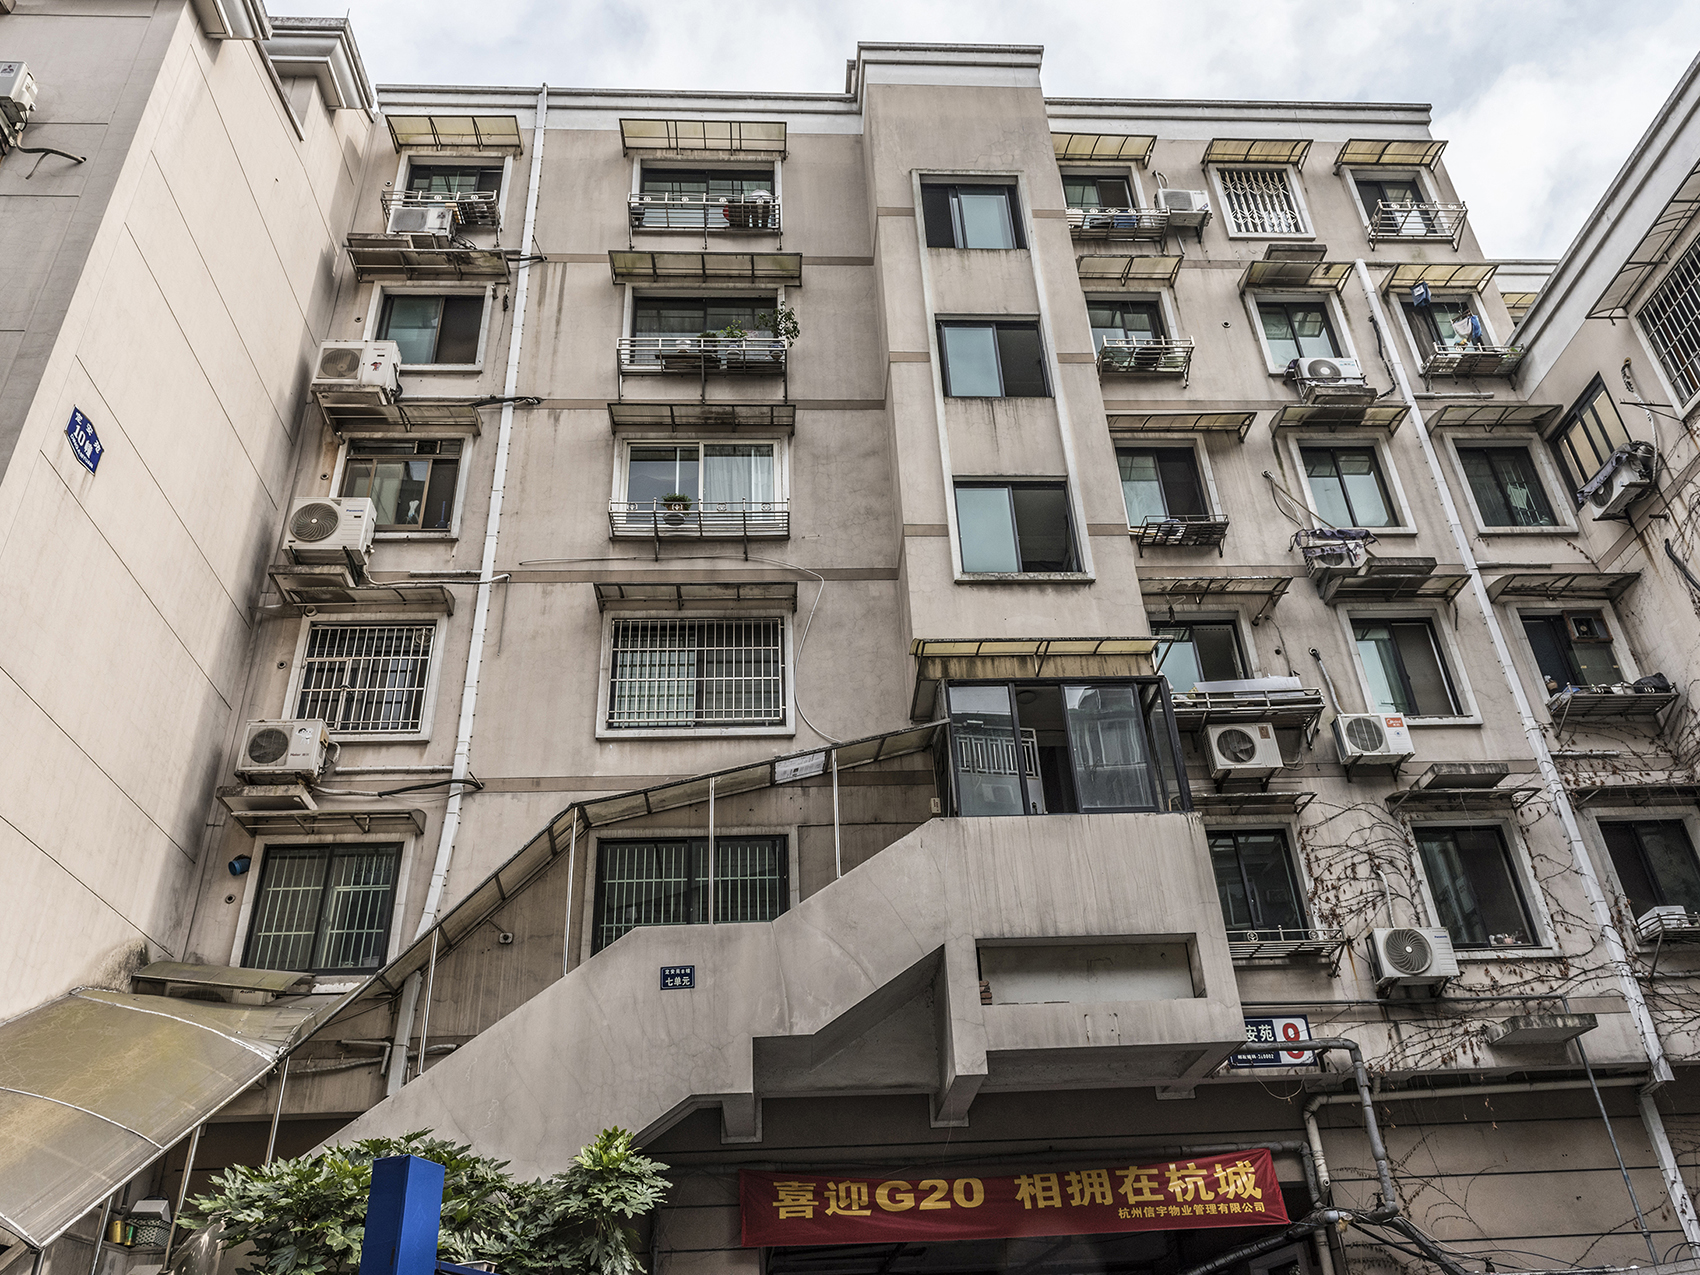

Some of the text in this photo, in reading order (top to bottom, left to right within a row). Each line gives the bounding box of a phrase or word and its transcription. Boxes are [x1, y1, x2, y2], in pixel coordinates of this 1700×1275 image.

[665, 976, 690, 986] 七单元
[772, 1160, 1263, 1220] 喜迎G20 相拥在杭城
